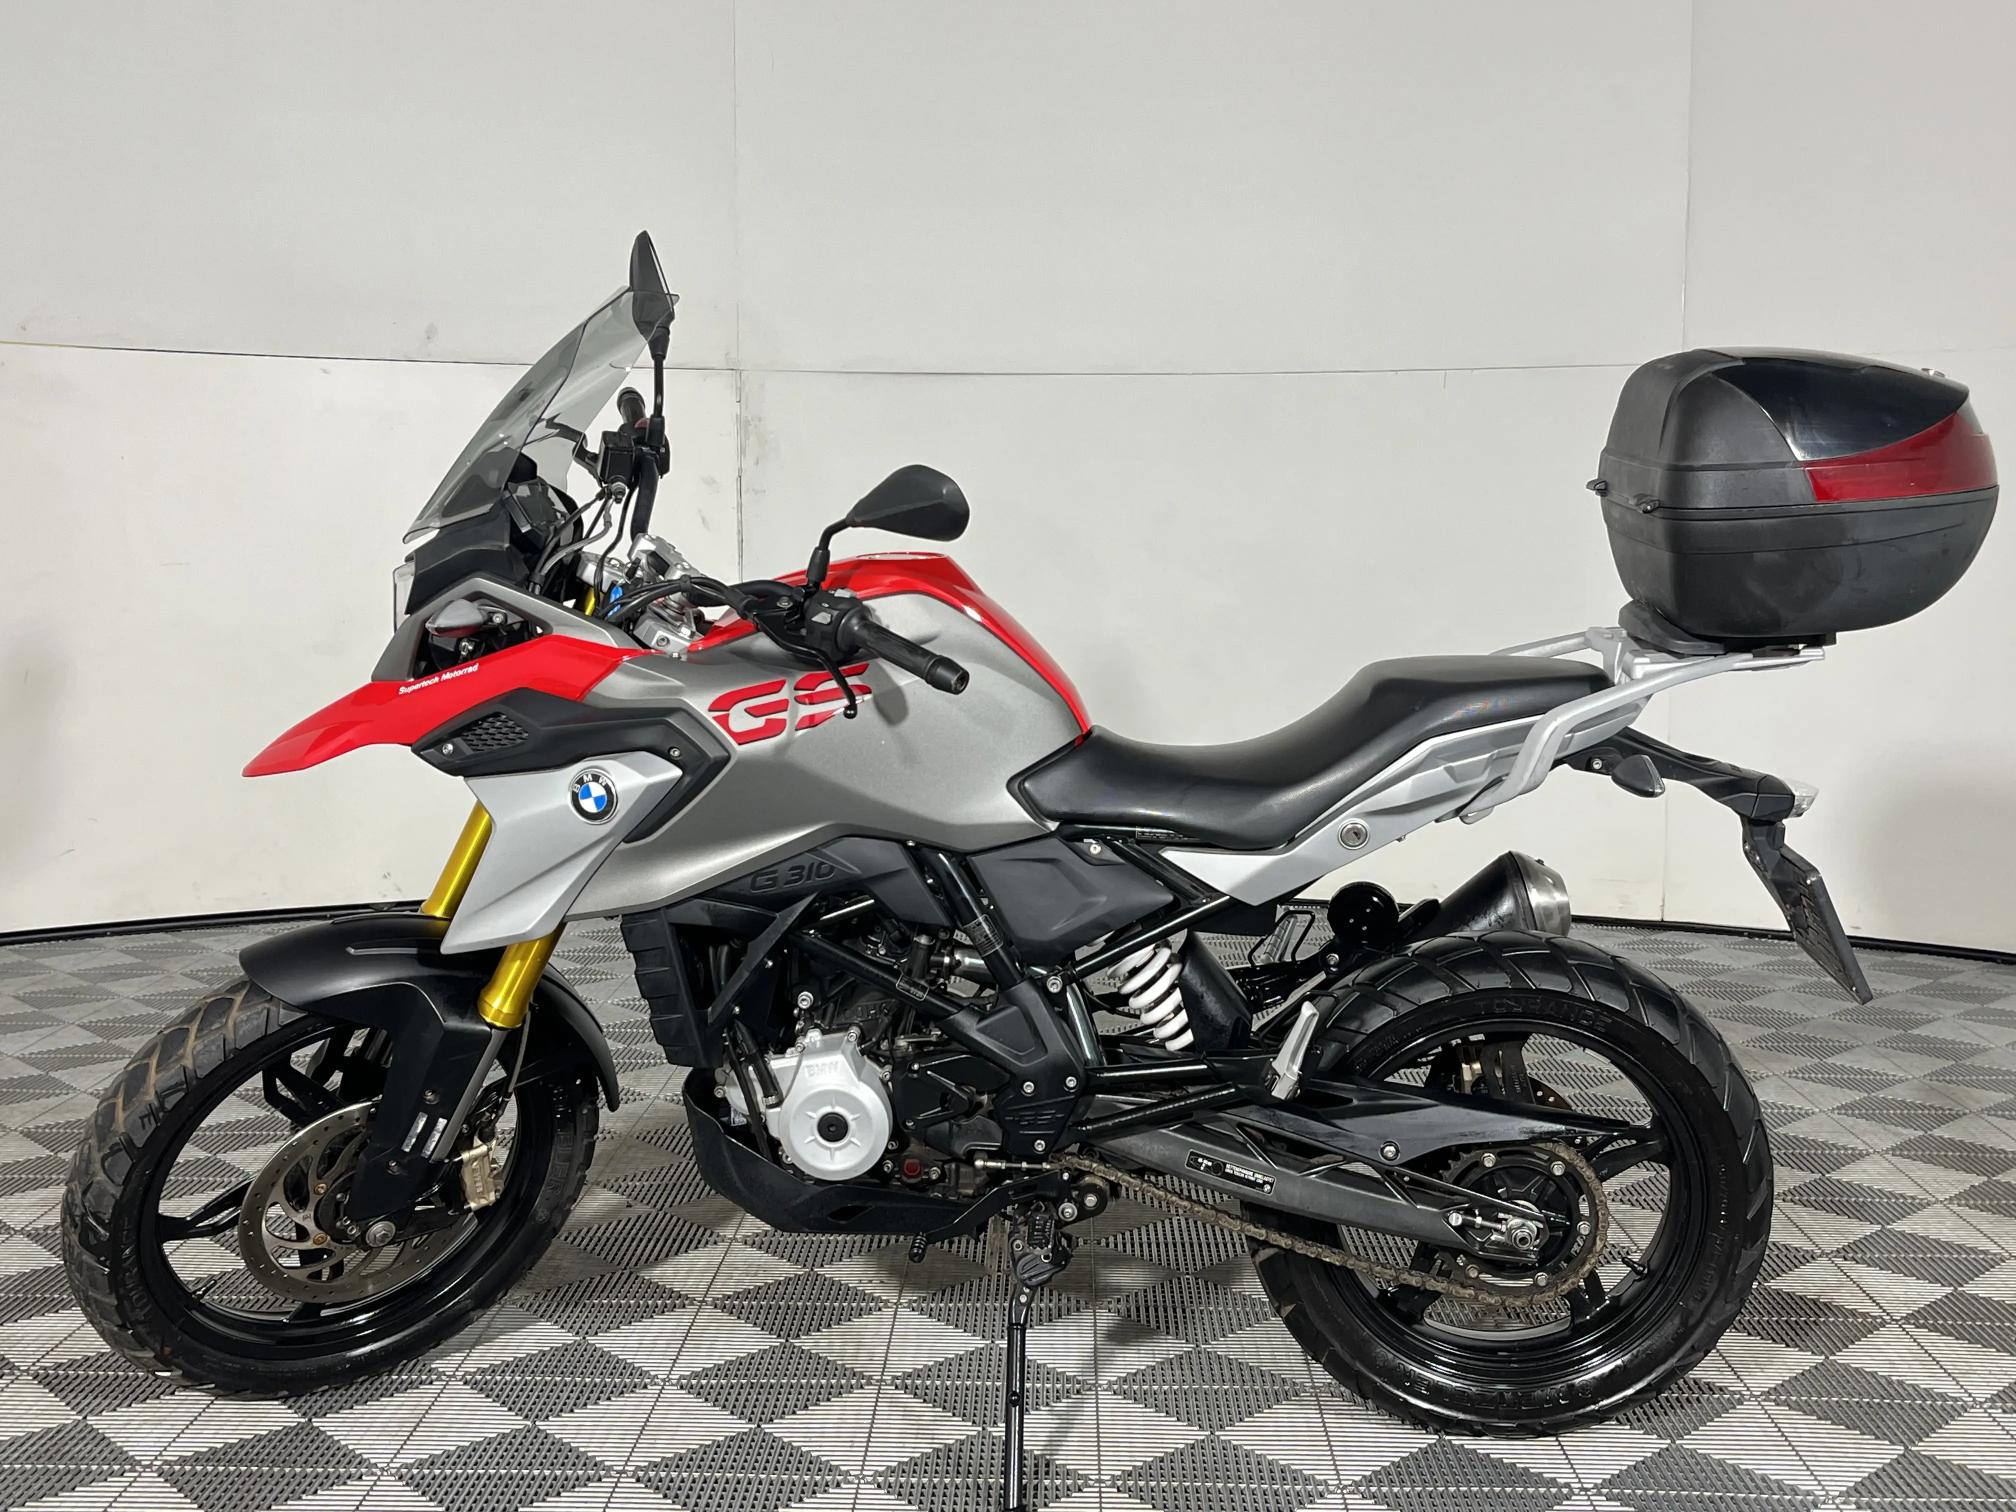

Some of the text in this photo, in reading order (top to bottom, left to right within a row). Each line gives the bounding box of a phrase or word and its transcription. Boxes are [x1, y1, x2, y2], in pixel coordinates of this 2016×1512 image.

[398, 663, 479, 695] Supertech Motorrad
[708, 663, 872, 745] GS
[571, 773, 608, 793] BMW
[750, 861, 836, 893] G 310
[805, 1061, 839, 1077] BMW
